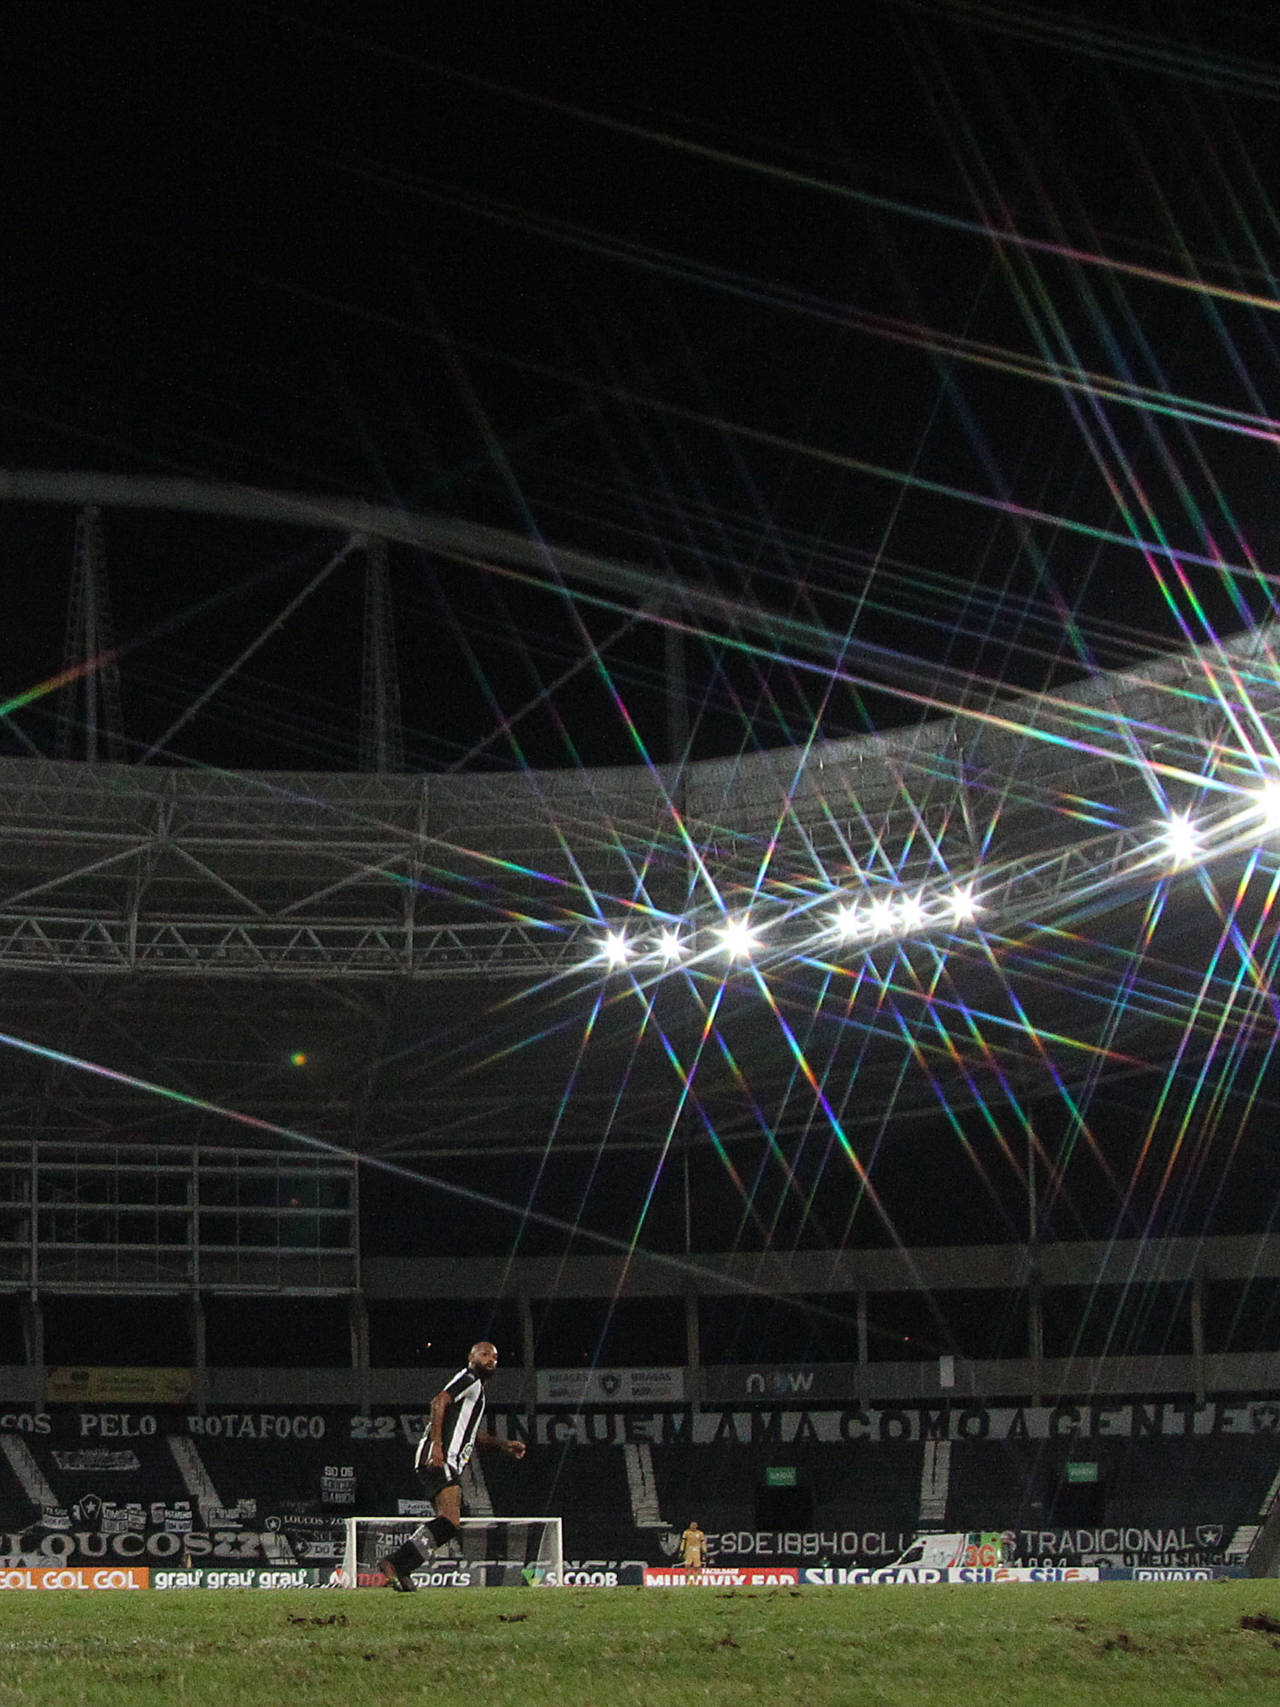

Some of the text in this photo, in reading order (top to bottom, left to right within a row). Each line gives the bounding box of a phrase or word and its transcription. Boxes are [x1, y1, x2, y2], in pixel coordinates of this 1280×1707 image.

[79, 1413, 158, 1437] PELO
[7, 1531, 214, 1558] LOUCOS
[703, 1531, 771, 1556] ESDE
[1019, 1527, 1195, 1554] TRADICIONAL
[43, 1571, 89, 1589] GOL
[92, 1571, 139, 1589] GOL
[546, 1571, 618, 1587] SCOOB
[805, 1567, 941, 1584] SUGGAR
